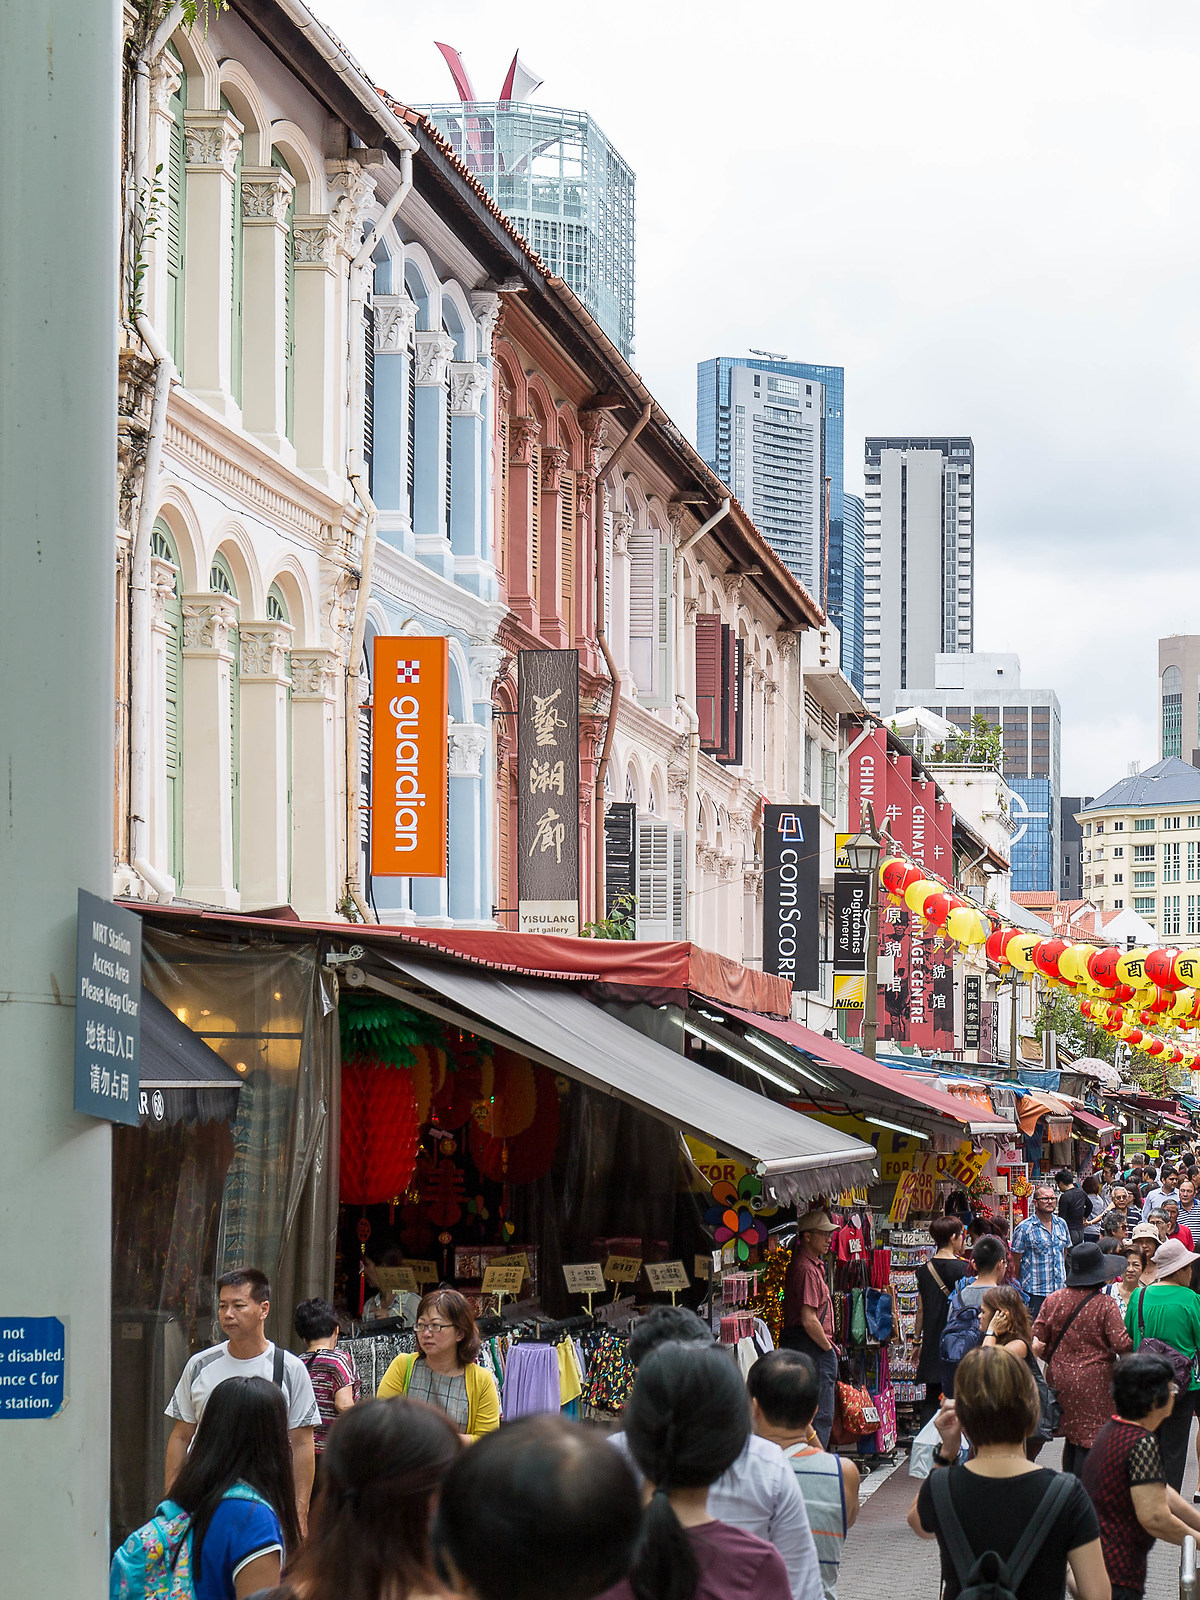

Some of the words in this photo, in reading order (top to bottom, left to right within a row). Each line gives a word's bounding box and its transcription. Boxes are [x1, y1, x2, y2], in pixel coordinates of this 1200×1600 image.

[389, 695, 426, 851] guardian
[521, 914, 576, 924] YISULANG
[840, 907, 851, 951] Synergy
[852, 889, 864, 954] Digitronics
[92, 921, 107, 943] MRT
[108, 929, 132, 956] Station
[541, 926, 569, 934] gallery
[911, 912, 924, 966] RITAGE
[92, 952, 115, 979] Access
[115, 963, 130, 984] Area
[1124, 959, 1146, 978] 酉
[1178, 959, 1198, 979] 酉
[81, 977, 104, 1005] Please
[104, 986, 121, 1016] Keep
[121, 996, 139, 1017] Clear
[910, 970, 924, 1024] CENTRE
[85, 1020, 135, 1061] 地铁出入口
[89, 1063, 130, 1102] 请勿占用
[699, 1164, 736, 1182] FOR
[886, 1161, 910, 1175] FOR
[916, 1172, 933, 1188] OR
[2, 1328, 26, 1340] not
[8, 1348, 65, 1363] disabled.
[29, 1373, 38, 1386] C
[41, 1371, 60, 1385] for
[5, 1396, 54, 1409] station.
